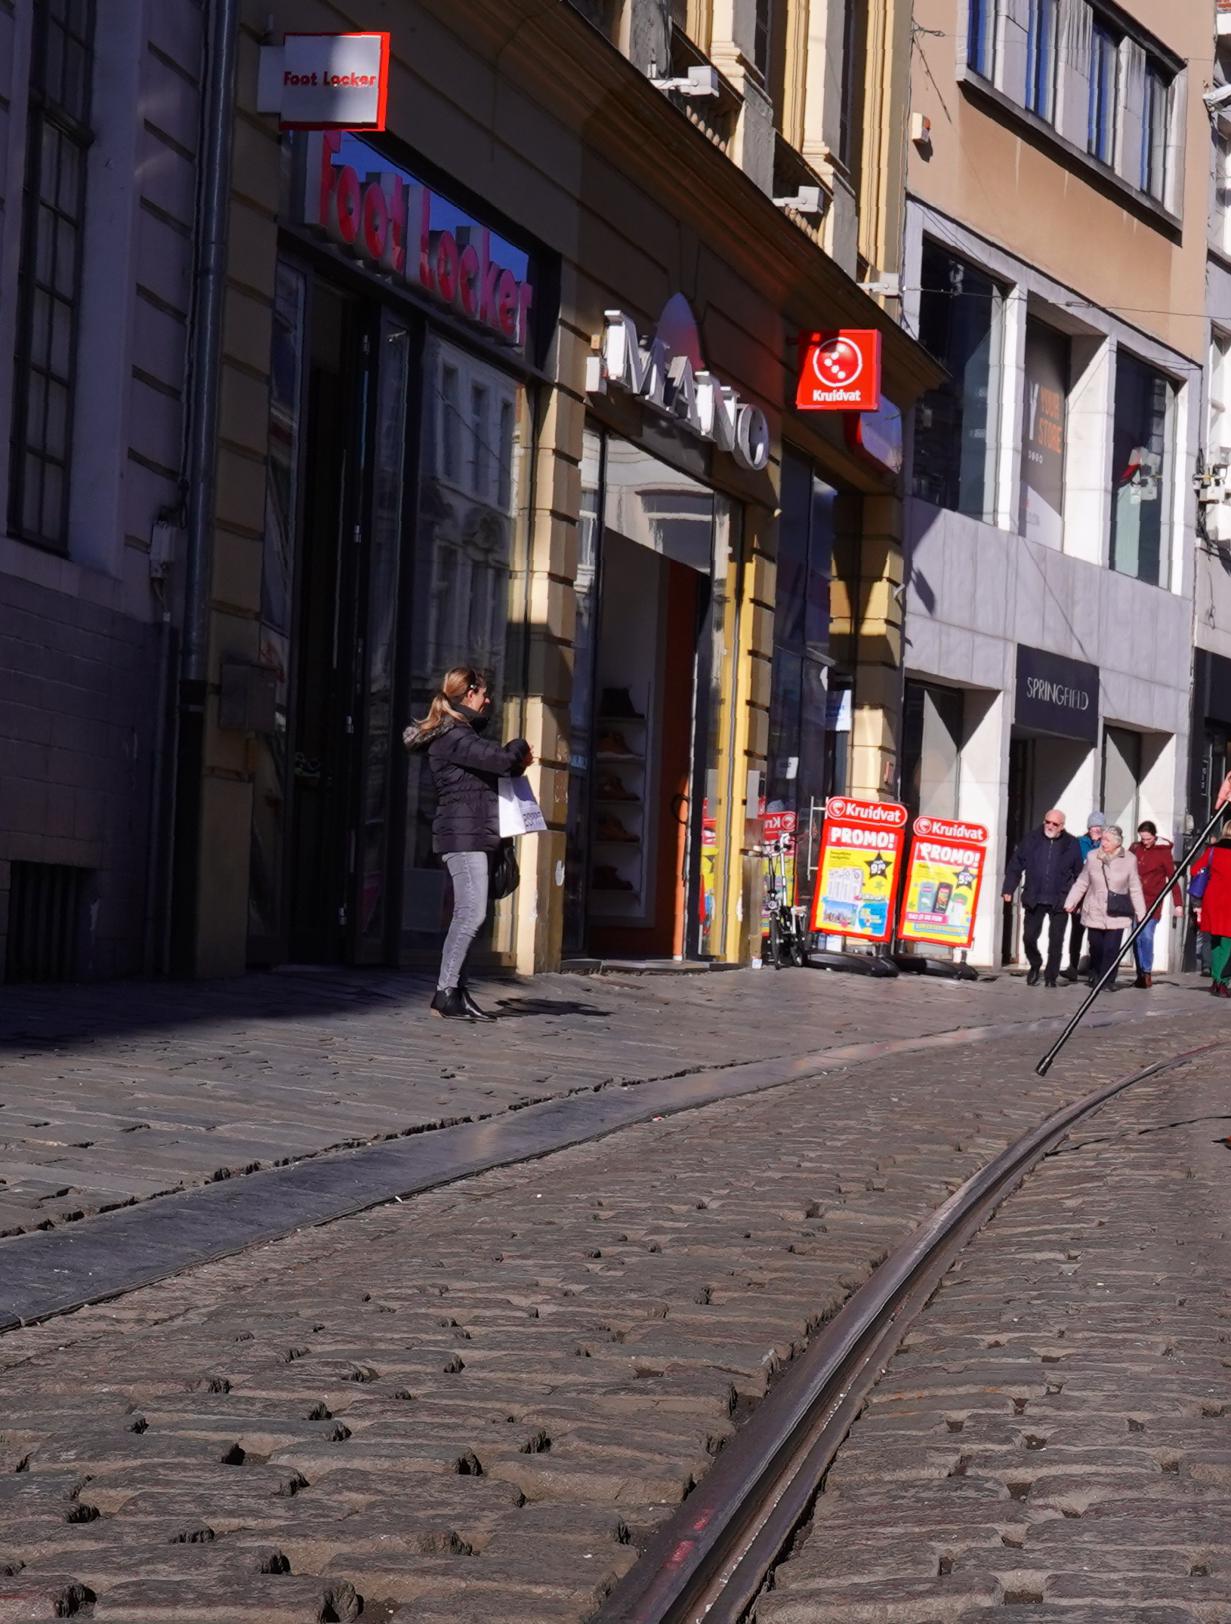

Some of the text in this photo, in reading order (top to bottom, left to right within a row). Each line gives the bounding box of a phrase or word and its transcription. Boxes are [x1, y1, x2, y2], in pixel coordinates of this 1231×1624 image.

[283, 71, 377, 88] Foot Locker
[419, 186, 533, 346] Locker
[812, 389, 862, 402] Kruidvat
[846, 802, 901, 823] Kruidvat
[830, 827, 896, 849] PROMO!
[932, 821, 984, 841] Kruidvat
[920, 842, 980, 868] PROMO!
